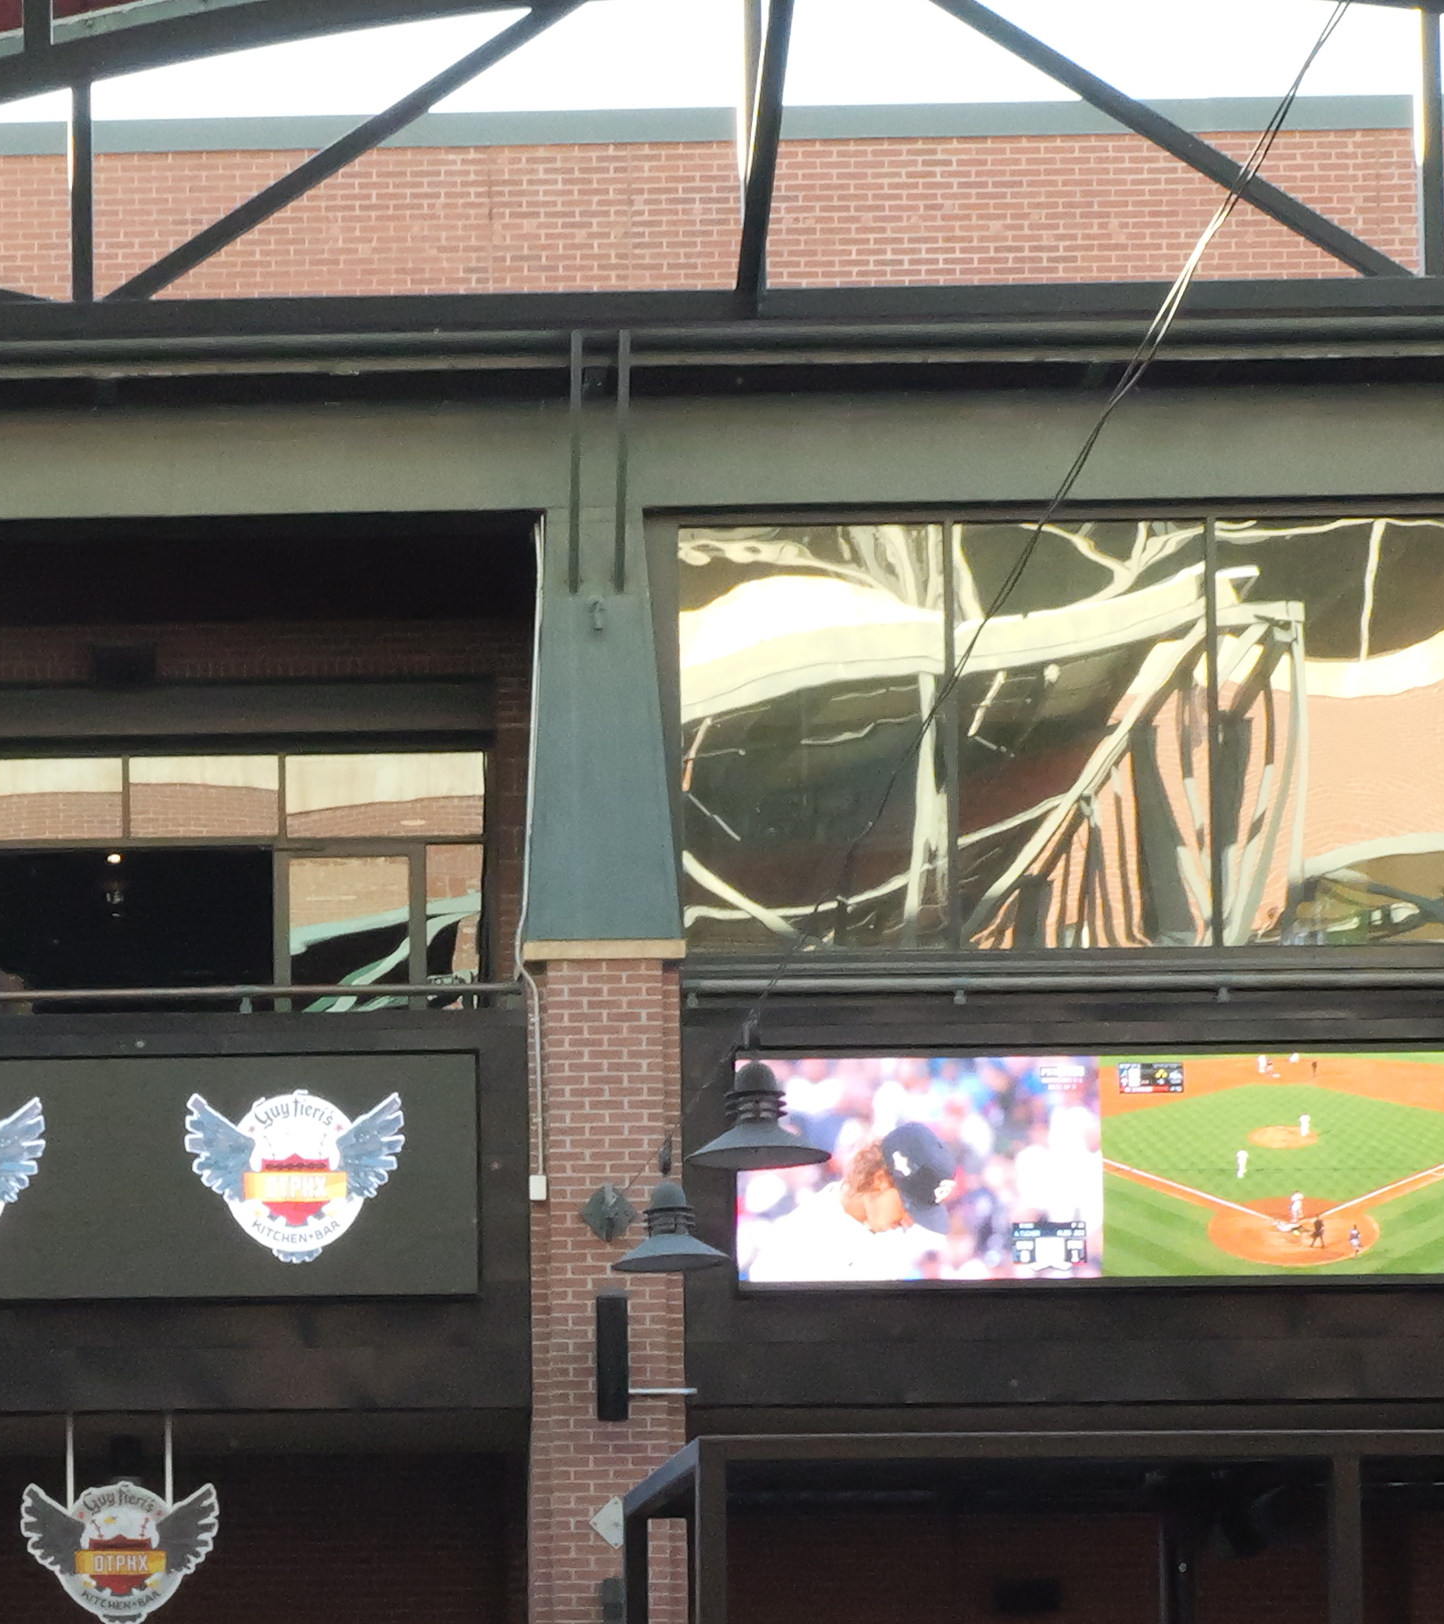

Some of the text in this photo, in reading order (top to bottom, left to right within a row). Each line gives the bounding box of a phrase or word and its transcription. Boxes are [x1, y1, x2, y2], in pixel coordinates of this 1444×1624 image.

[254, 1094, 334, 1130] Guy Fieri's
[82, 1491, 115, 1516] Guy
[94, 1555, 149, 1572] DTPHX
